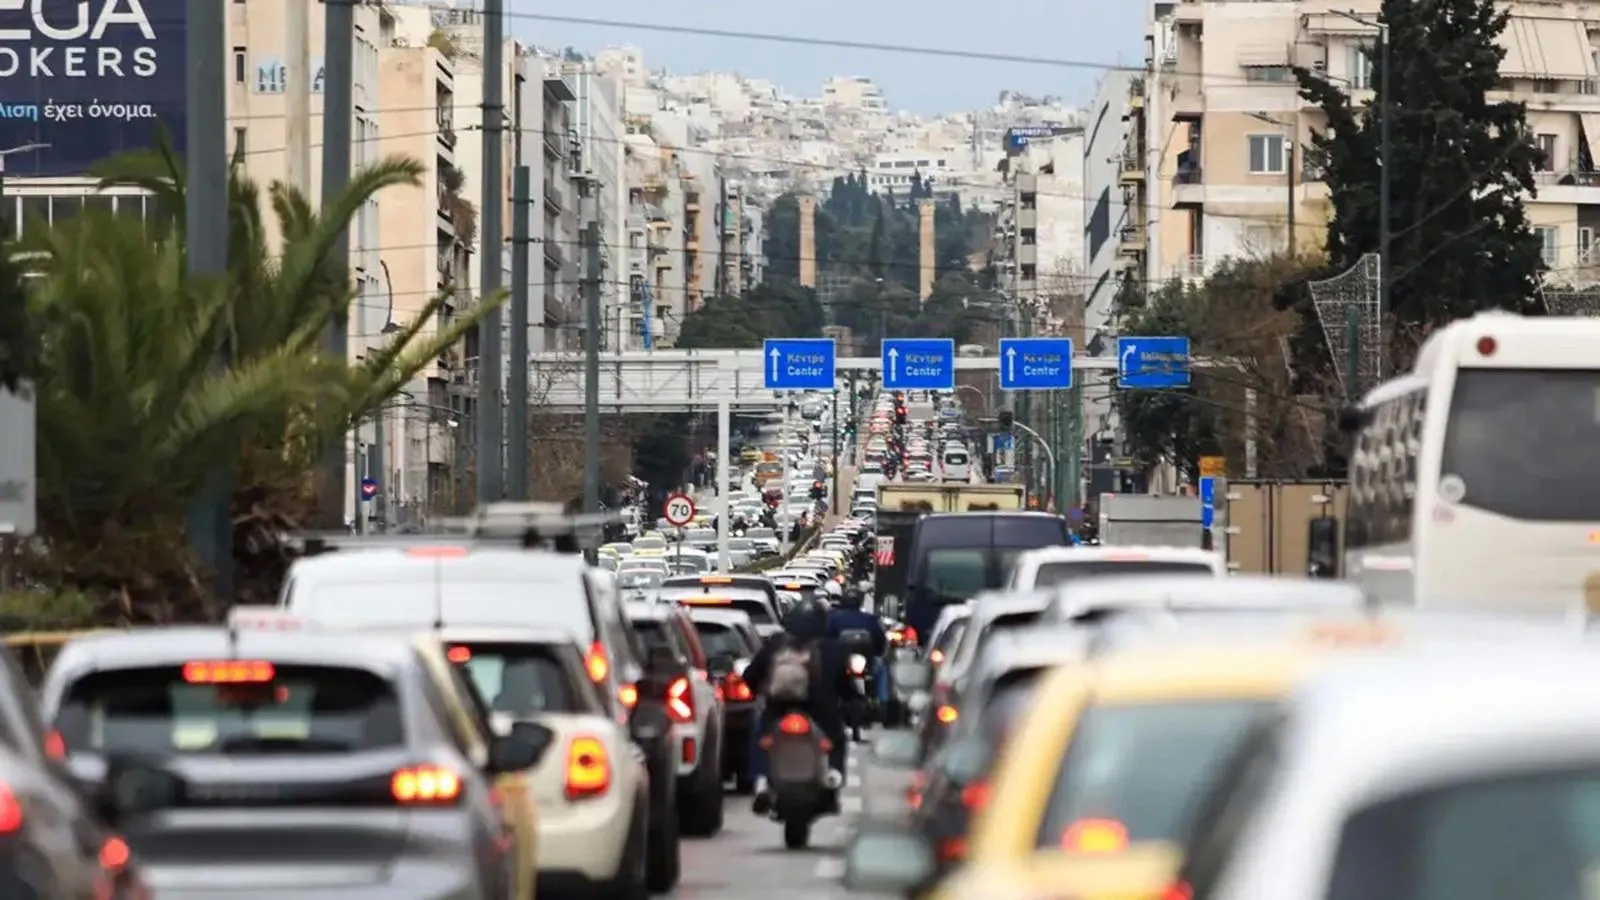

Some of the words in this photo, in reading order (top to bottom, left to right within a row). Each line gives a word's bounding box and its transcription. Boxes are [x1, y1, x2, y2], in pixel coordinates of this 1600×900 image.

[0, 47, 157, 77] OKERS
[44, 98, 84, 122] έχει
[88, 98, 157, 122] όνομα.
[787, 366, 823, 376] Center
[905, 366, 942, 376] Center
[1023, 366, 1060, 376] Center
[671, 504, 689, 517] 70
